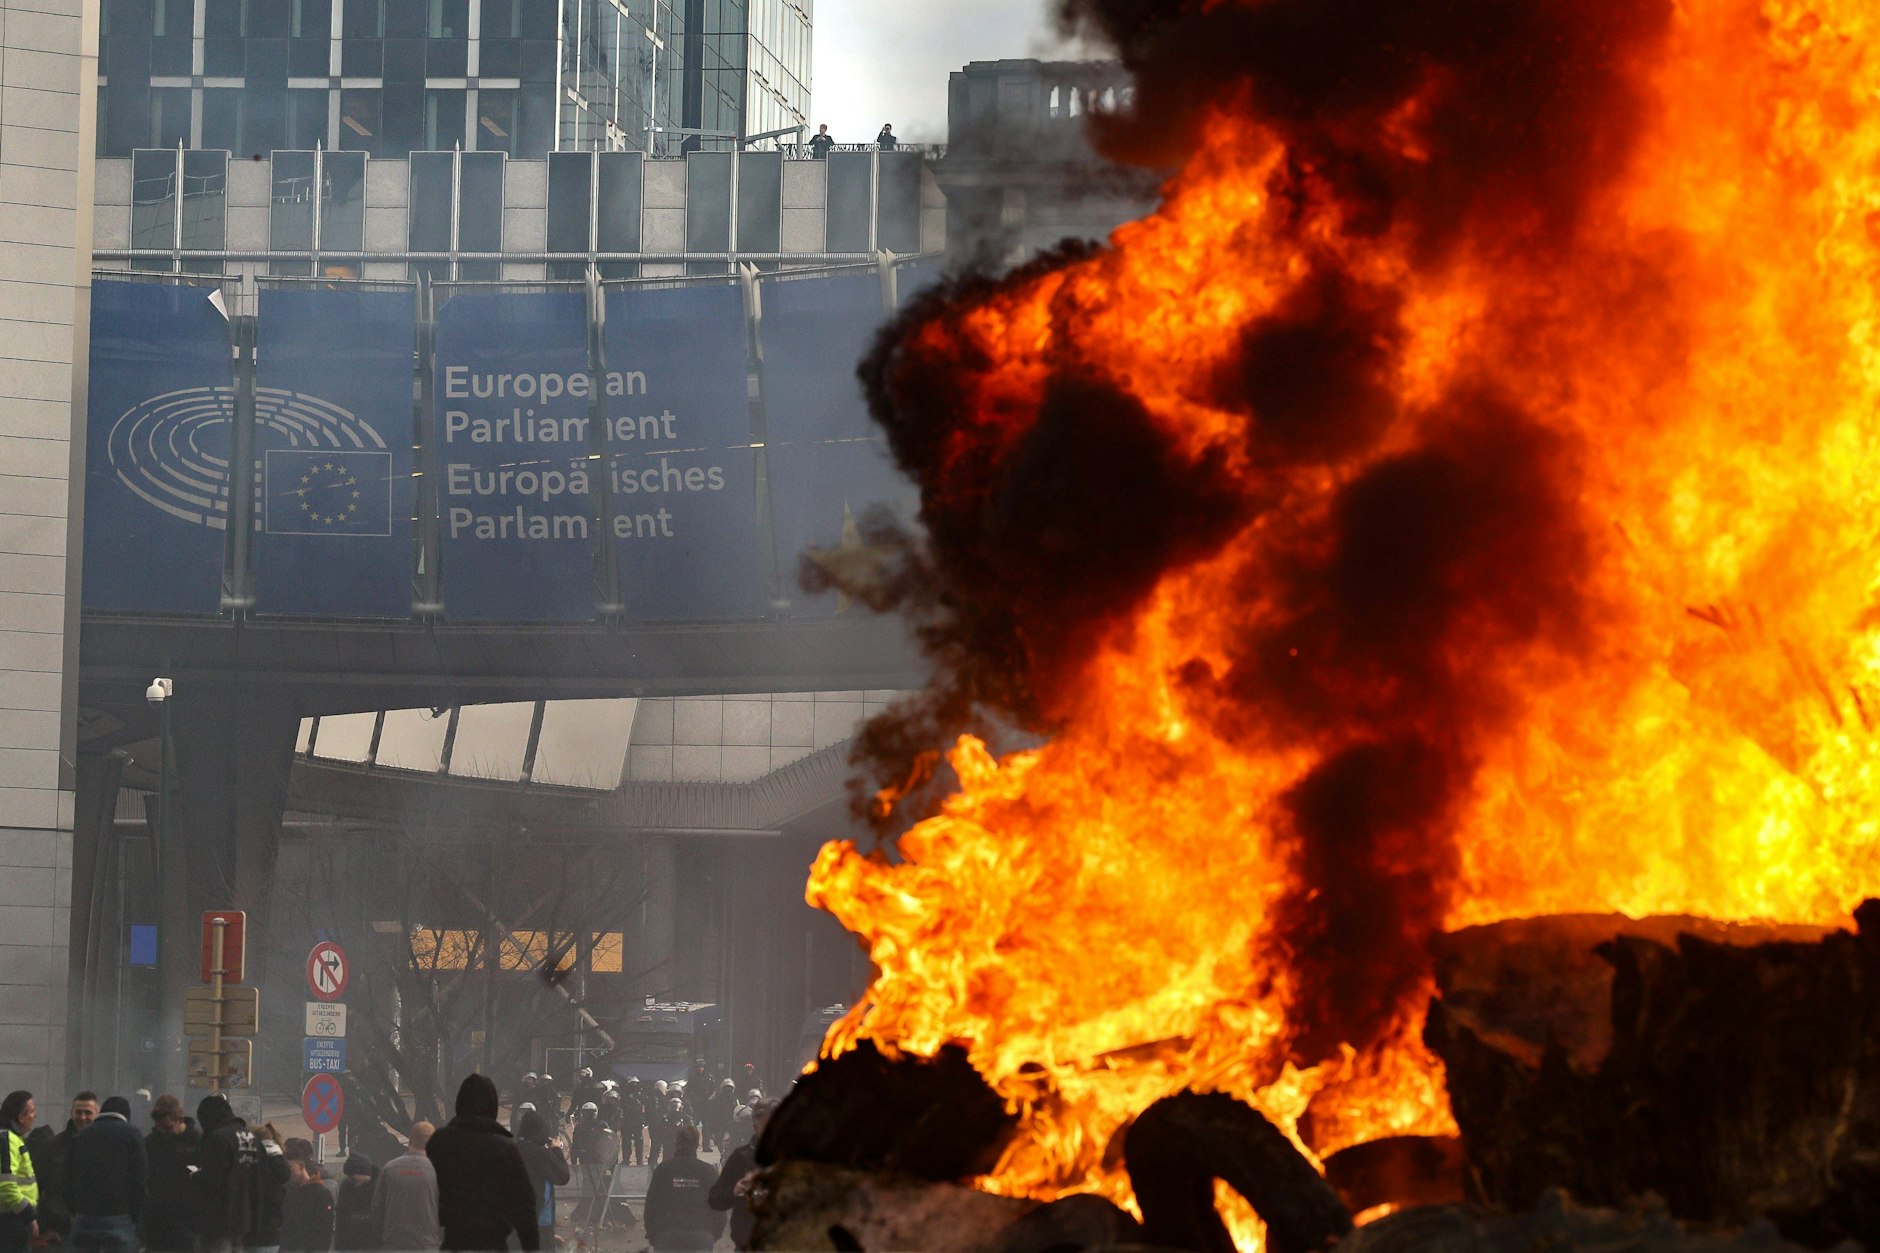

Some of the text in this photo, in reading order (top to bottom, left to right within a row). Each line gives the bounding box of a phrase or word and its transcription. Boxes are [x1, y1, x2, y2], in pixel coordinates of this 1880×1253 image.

[445, 366, 647, 404] European
[445, 408, 677, 443] Parliament
[448, 458, 725, 502] Europäisches
[450, 505, 674, 539] Parlament
[309, 1058, 340, 1070] BUS-TAXI
